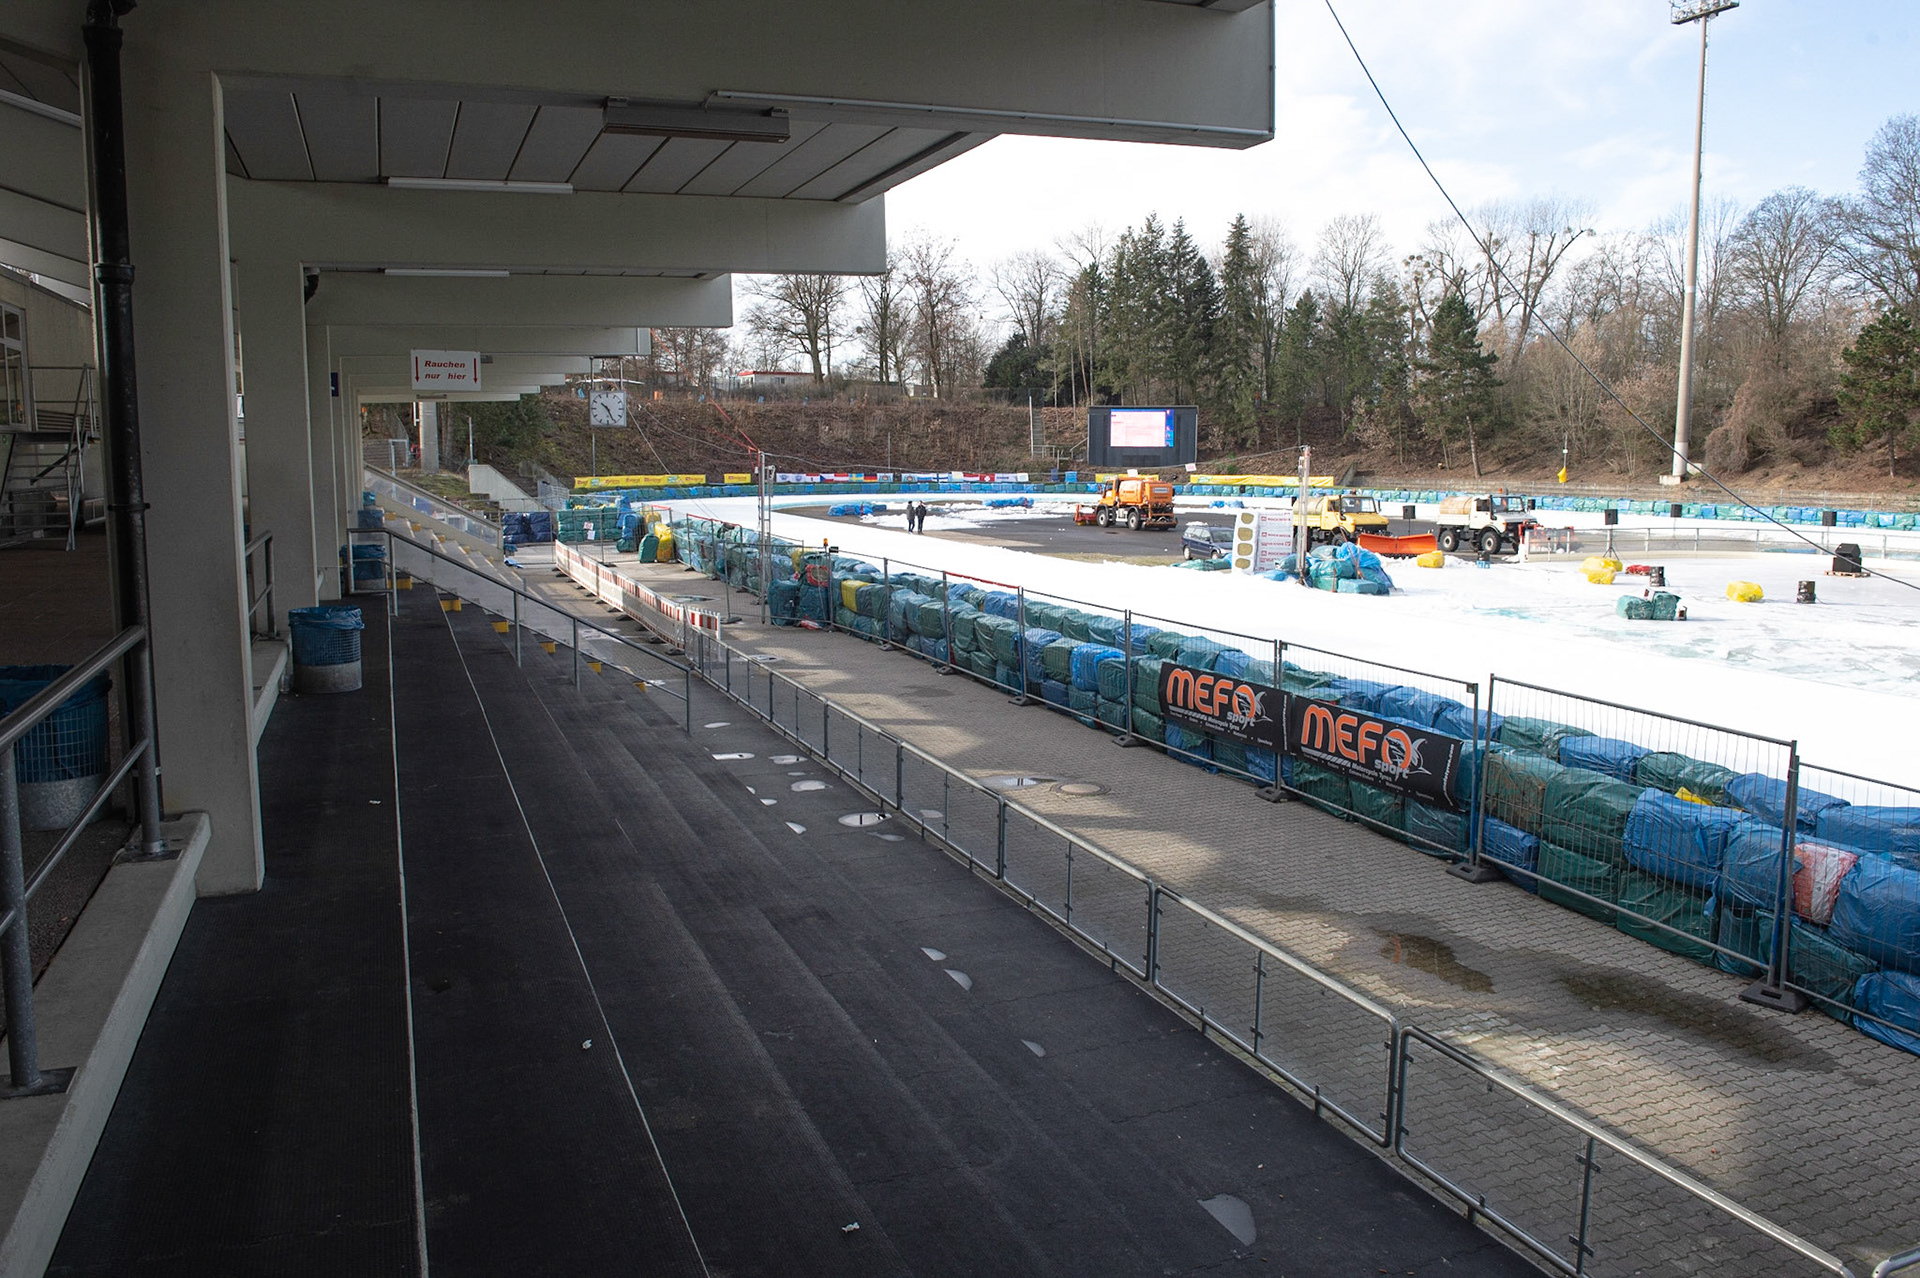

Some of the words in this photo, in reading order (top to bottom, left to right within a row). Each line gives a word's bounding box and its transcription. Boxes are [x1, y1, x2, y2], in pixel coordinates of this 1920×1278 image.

[424, 360, 466, 369] Rauchen
[447, 372, 467, 380] hier
[1166, 668, 1256, 719] MEFO
[1226, 711, 1256, 730] sport
[1300, 704, 1412, 769] MEFO
[1374, 759, 1410, 781] sport
